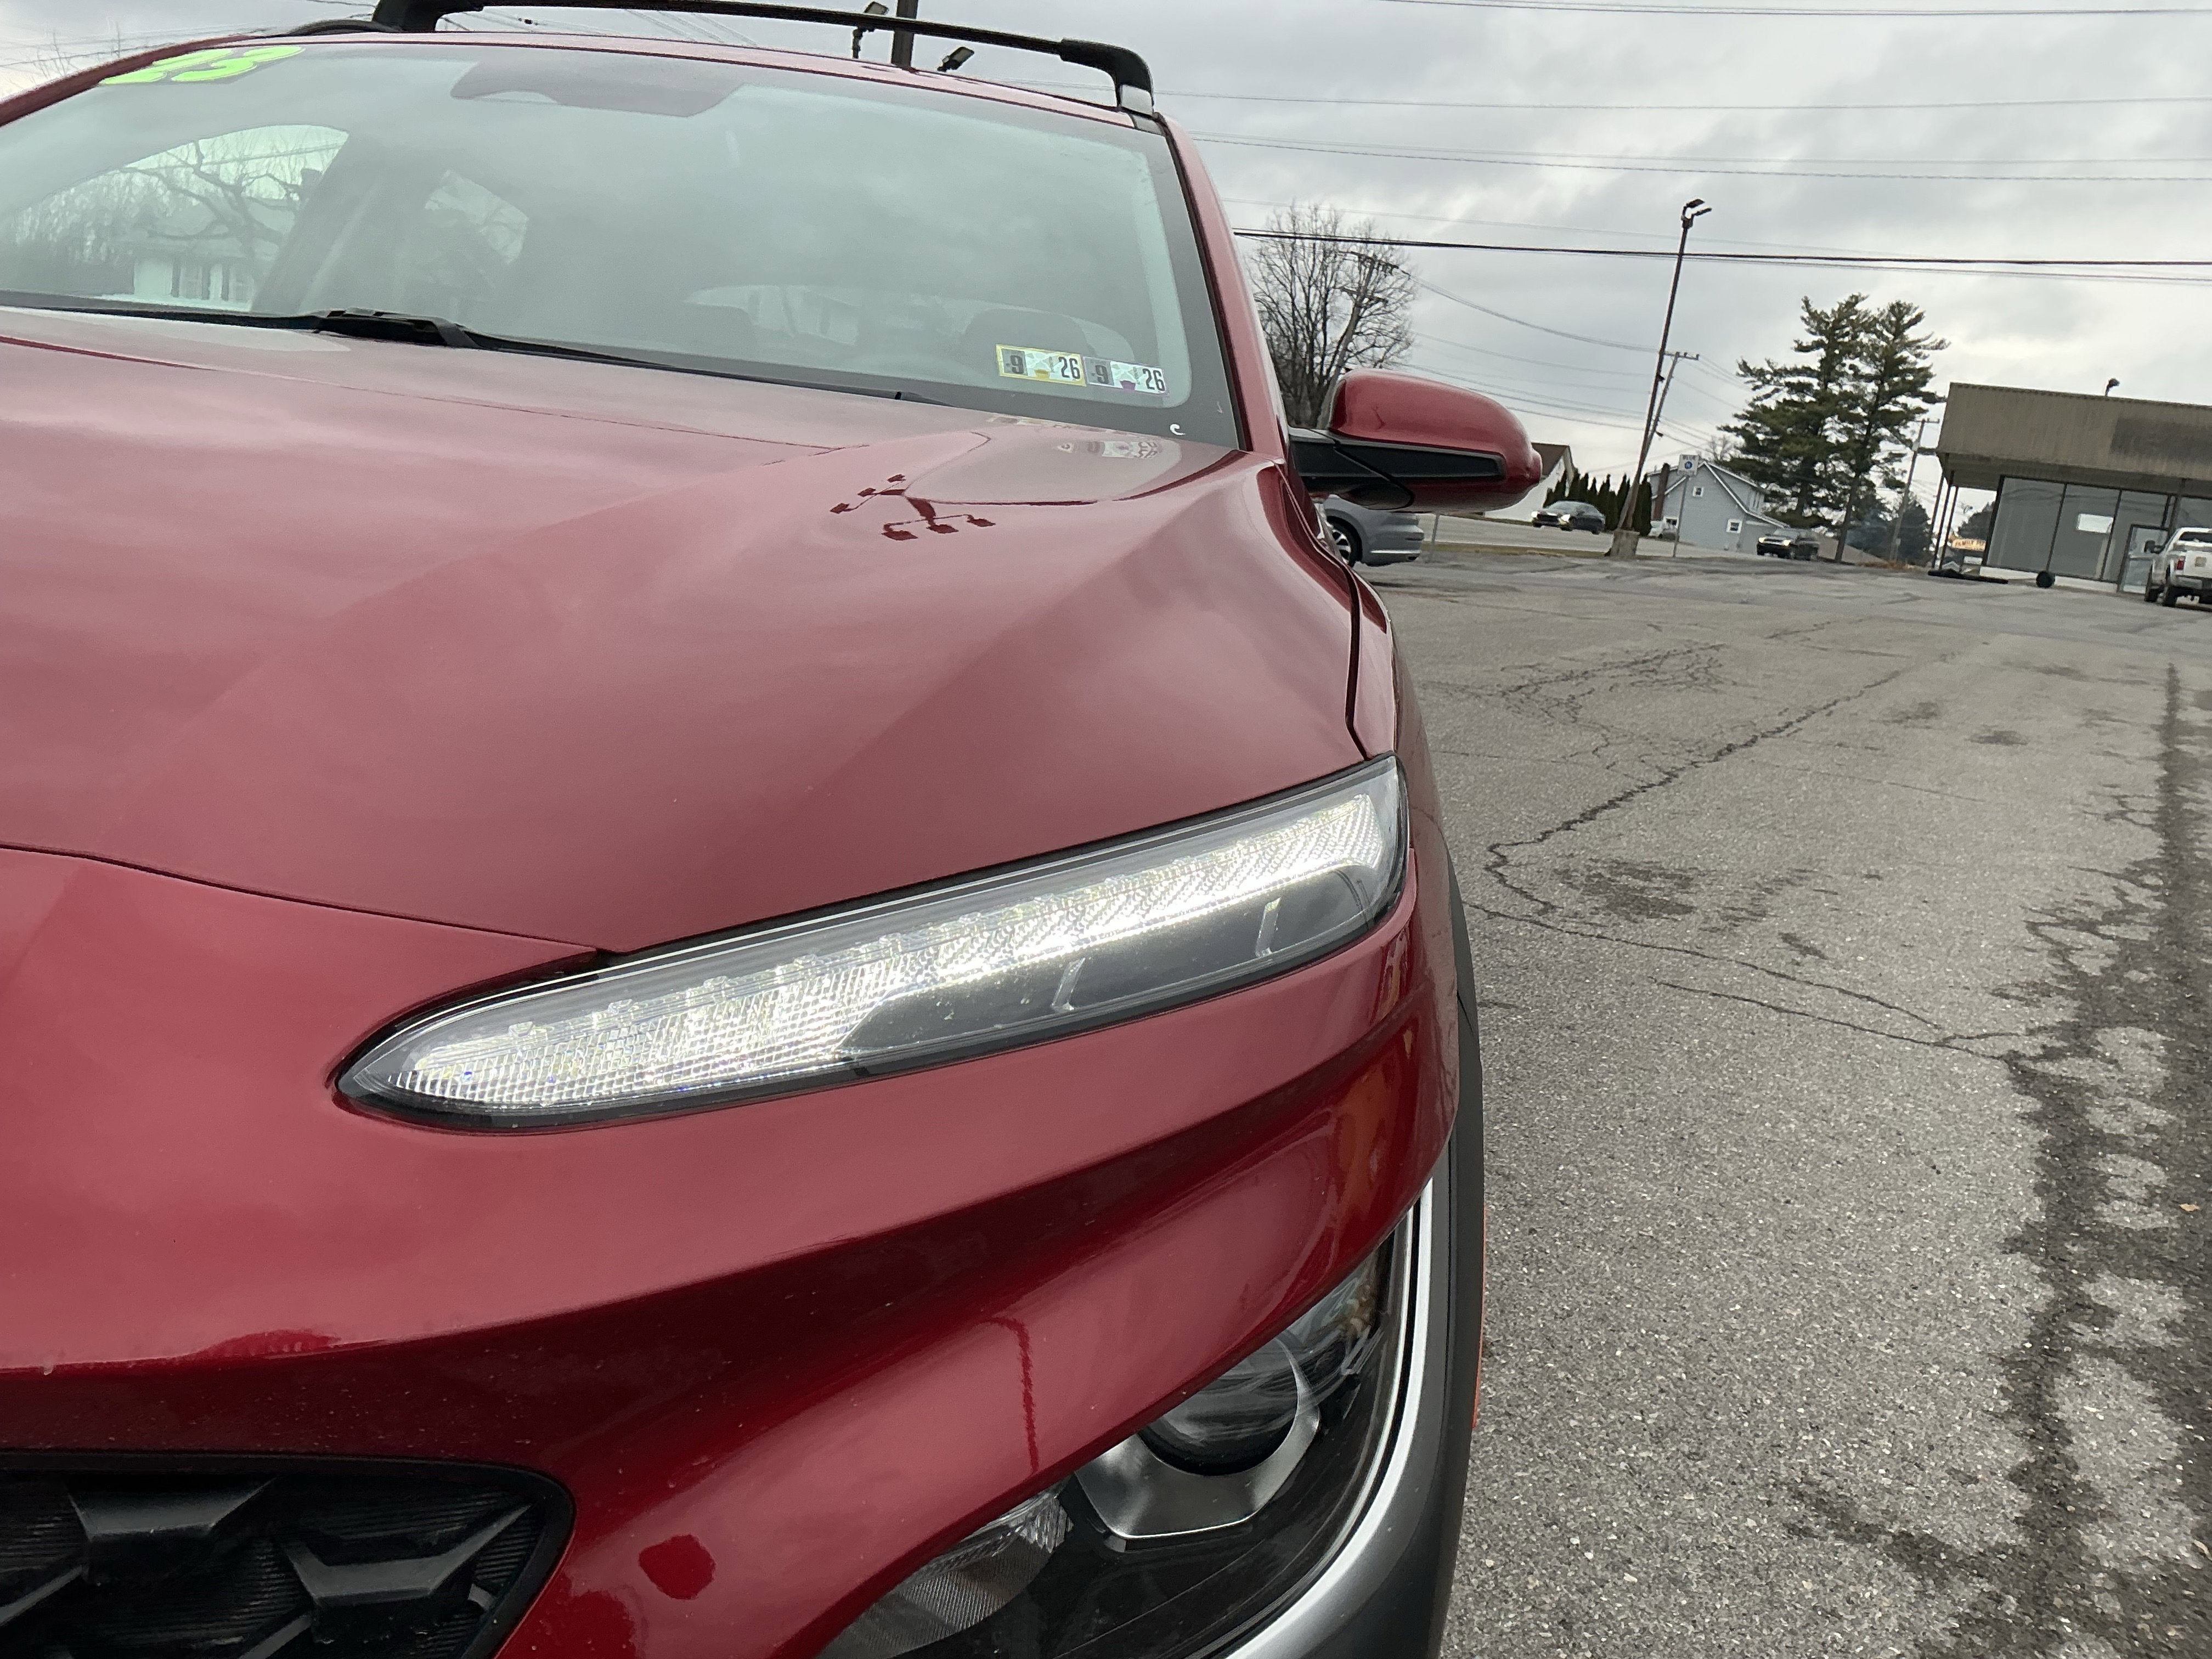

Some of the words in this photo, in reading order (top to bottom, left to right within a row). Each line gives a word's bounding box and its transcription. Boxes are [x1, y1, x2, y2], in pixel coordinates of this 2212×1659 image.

[100, 46, 305, 84] 23
[1009, 355, 1024, 375] 9
[1058, 357, 1080, 380] 26
[1095, 365, 1109, 385] 9
[1142, 368, 1165, 391] 26
